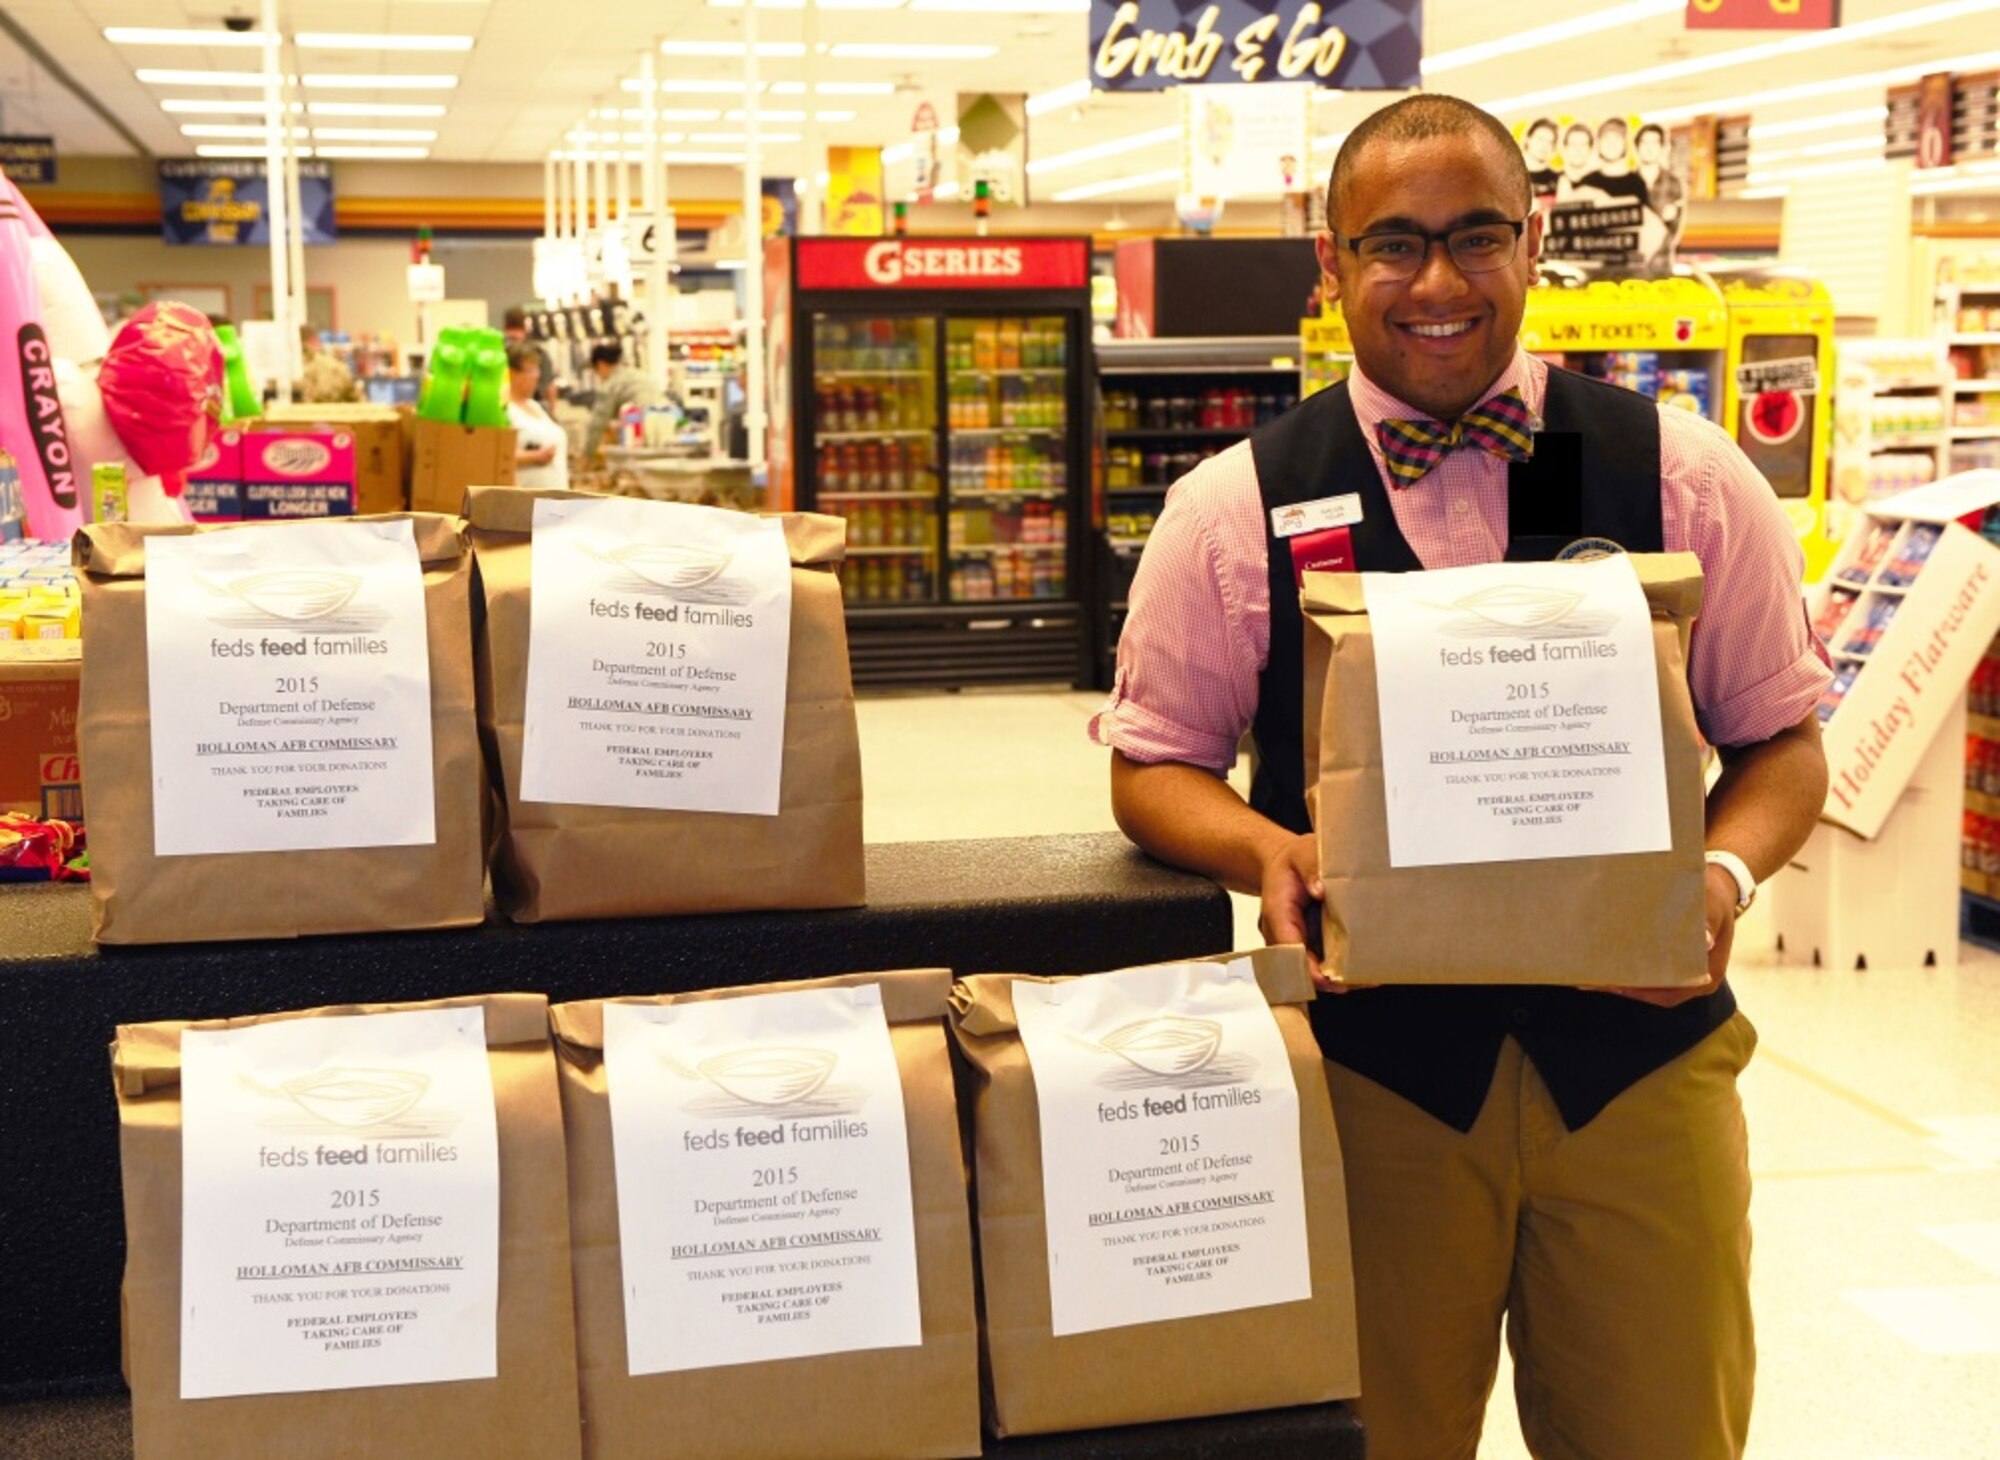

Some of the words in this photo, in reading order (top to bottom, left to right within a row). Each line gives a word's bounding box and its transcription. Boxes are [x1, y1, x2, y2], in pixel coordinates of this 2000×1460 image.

[1094, 2, 1223, 80] Grab
[1233, 13, 1278, 80] &
[1276, 4, 1347, 77] Go
[902, 247, 1022, 277] SERIES
[1550, 325, 1581, 340] WIN
[1590, 323, 1656, 340] TICKETS
[24, 339, 76, 495] CRAYON
[269, 501, 329, 515] LONGER
[590, 599, 629, 618] feds
[635, 603, 678, 622] feed
[685, 606, 753, 627] families
[211, 638, 254, 657] feds
[260, 638, 306, 656] feed
[313, 637, 388, 655] families
[646, 642, 686, 658] 2015
[1440, 647, 1483, 666] feds
[1489, 644, 1536, 663] feed
[1542, 641, 1617, 661] families
[592, 660, 665, 677] Department
[670, 666, 684, 677] of
[687, 667, 737, 681] Defense
[275, 677, 319, 693] 2015
[1506, 682, 1550, 700] 2015
[1831, 695, 1915, 813] Holiday
[1901, 560, 1991, 696] Flatware
[219, 701, 299, 716] Department
[303, 700, 319, 712] of
[322, 699, 375, 711] Defense
[568, 697, 642, 711] HOLLOMAN
[647, 702, 670, 713] AFB
[672, 704, 752, 719] COMMISSARY
[1451, 708, 1530, 724] Department
[1535, 706, 1550, 719] of
[1552, 704, 1607, 717] Defense
[580, 722, 613, 732] THANK
[616, 723, 636, 733] YOU
[638, 725, 656, 734] FOR
[660, 726, 686, 736] YOUR
[687, 728, 741, 740] DONATIONS
[197, 740, 276, 754] HOLLOMAN
[281, 740, 307, 750] AFB
[309, 737, 398, 749] COMMISSARY
[606, 745, 651, 756] FEDERAL
[654, 748, 713, 759] EMPLOYEES
[1430, 748, 1509, 762] HOLLOMAN
[1513, 746, 1539, 758] AFB
[1542, 742, 1631, 756] COMMISSARY
[211, 766, 247, 776] THANK
[251, 765, 272, 774] YOU
[275, 764, 294, 773] FOR
[299, 763, 327, 772] YOUR
[329, 762, 387, 771] DONATIONS
[618, 757, 656, 767] TAKING
[658, 759, 685, 768] CARE
[687, 761, 700, 769] OF
[1445, 774, 1481, 785] THANK
[1484, 773, 1506, 783] YOU
[1509, 772, 1528, 781] FOR
[1531, 770, 1560, 780] YOUR
[1562, 767, 1621, 778] DONATIONS
[243, 787, 291, 797] FEDERAL
[295, 785, 359, 795] EMPLOYEES
[1477, 795, 1526, 805] FEDERAL
[1529, 792, 1594, 803] EMPLOYEES
[257, 799, 298, 807] TAKING
[301, 797, 329, 806] CARE
[332, 796, 346, 804] OF
[1492, 806, 1533, 816] TAKING
[1535, 804, 1564, 814] CARE
[1566, 803, 1581, 811] OF
[277, 809, 327, 817] FAMILIES
[1097, 1102, 1138, 1123] feds
[1143, 1094, 1186, 1117] feed
[1192, 1089, 1261, 1111] families
[684, 1130, 729, 1151] feds
[735, 1125, 784, 1146] feed
[792, 1120, 867, 1143] families
[1160, 1135, 1200, 1155] 2015
[259, 1146, 308, 1168] feds
[316, 1144, 368, 1165] feed
[376, 1142, 458, 1164] families
[753, 1167, 798, 1186] 2015
[1109, 1163, 1182, 1183] Department
[1186, 1159, 1202, 1173] of
[1203, 1154, 1252, 1170] Defense
[331, 1190, 380, 1208] 2015
[694, 1195, 777, 1215] Department
[782, 1192, 800, 1205] of
[801, 1188, 858, 1203] Defense
[1089, 1205, 1163, 1224] HOLLOMAN
[1167, 1201, 1190, 1214] AFB
[1193, 1191, 1275, 1210] COMMISSARY
[266, 1218, 356, 1236] Department
[360, 1216, 378, 1228] of
[382, 1214, 442, 1228] Defense
[1103, 1235, 1137, 1247] THANK
[1139, 1231, 1160, 1242] YOU
[1162, 1228, 1181, 1239] FOR
[1183, 1224, 1209, 1236] YOUR
[1211, 1217, 1266, 1232] DONATIONS
[285, 1237, 324, 1248] Defense
[326, 1234, 385, 1246] Commissary
[388, 1232, 422, 1244] Agency
[671, 1239, 755, 1257] HOLLOMAN
[760, 1236, 786, 1249] AFB
[789, 1228, 881, 1246] COMMISSARY
[1133, 1253, 1178, 1266] FEDERAL
[1181, 1244, 1240, 1259] EMPLOYEES
[237, 1263, 328, 1278] HOLLOMAN
[334, 1261, 362, 1274] AFB
[365, 1256, 463, 1271] COMMISSARY
[687, 1269, 725, 1280] THANK
[729, 1266, 752, 1278] YOU
[755, 1264, 775, 1275] FOR
[778, 1261, 808, 1272] YOUR
[811, 1255, 871, 1270] DONATIONS
[1147, 1264, 1185, 1276] TAKING
[1187, 1260, 1214, 1271] CARE
[1216, 1257, 1229, 1267] OF
[252, 1293, 293, 1304] THANK
[298, 1292, 322, 1302] YOU
[326, 1290, 348, 1300] FOR
[351, 1288, 382, 1298] YOUR
[386, 1283, 450, 1295] DONATIONS
[722, 1291, 774, 1302] FEDERAL
[776, 1283, 842, 1298] EMPLOYEES
[736, 1302, 780, 1313] TAKING
[783, 1299, 813, 1310] CARE
[815, 1296, 829, 1305] OF
[288, 1316, 344, 1328] FEDERAL
[346, 1311, 418, 1324] EMPLOYEES
[758, 1311, 810, 1324] FAMILIES
[302, 1328, 349, 1340] TAKING
[352, 1326, 384, 1336] CARE
[386, 1324, 403, 1334] OF
[324, 1339, 381, 1350] FAMILIES
